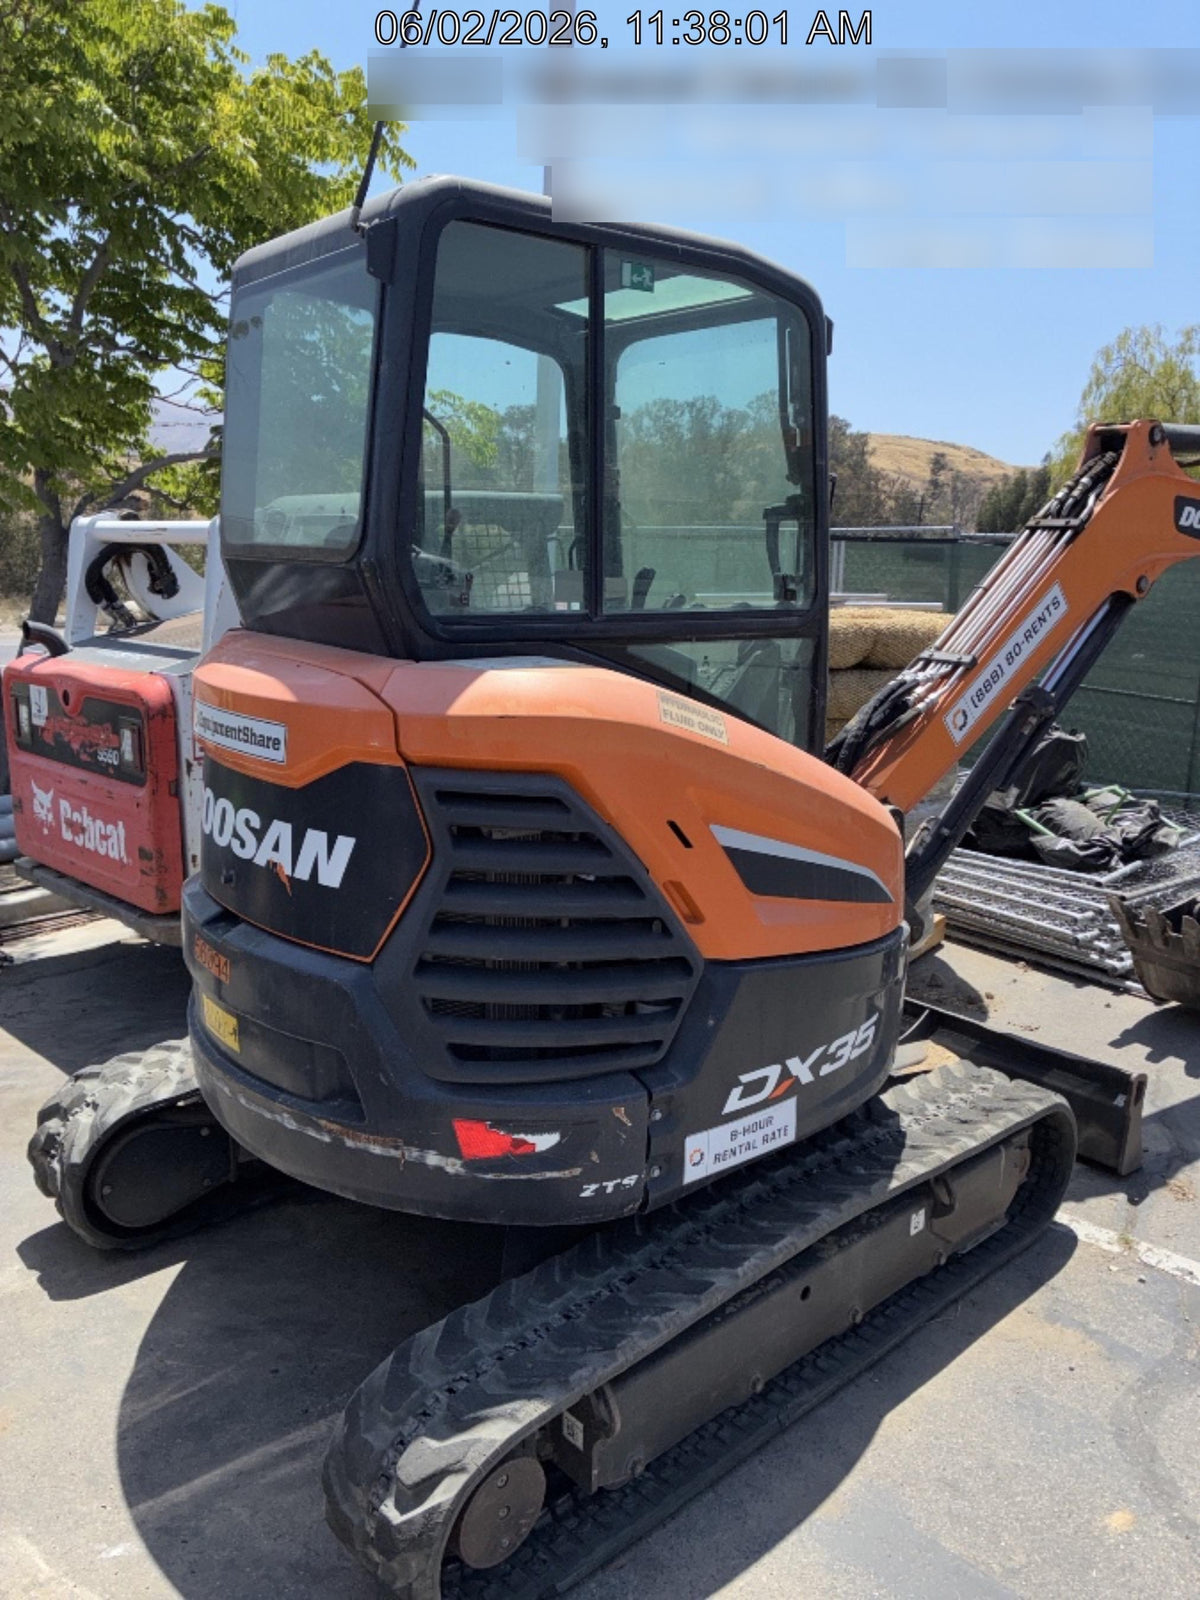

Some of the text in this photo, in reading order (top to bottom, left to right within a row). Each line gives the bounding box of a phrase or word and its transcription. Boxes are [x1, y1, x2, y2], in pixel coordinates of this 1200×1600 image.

[971, 596, 1060, 708] (888) 80-RENTS
[60, 798, 127, 865] Bobcat
[202, 787, 356, 889] OOSAN
[722, 1012, 879, 1115] DX35
[713, 1125, 789, 1164] RENTAL RATE
[730, 1116, 774, 1141] 8-HOUR
